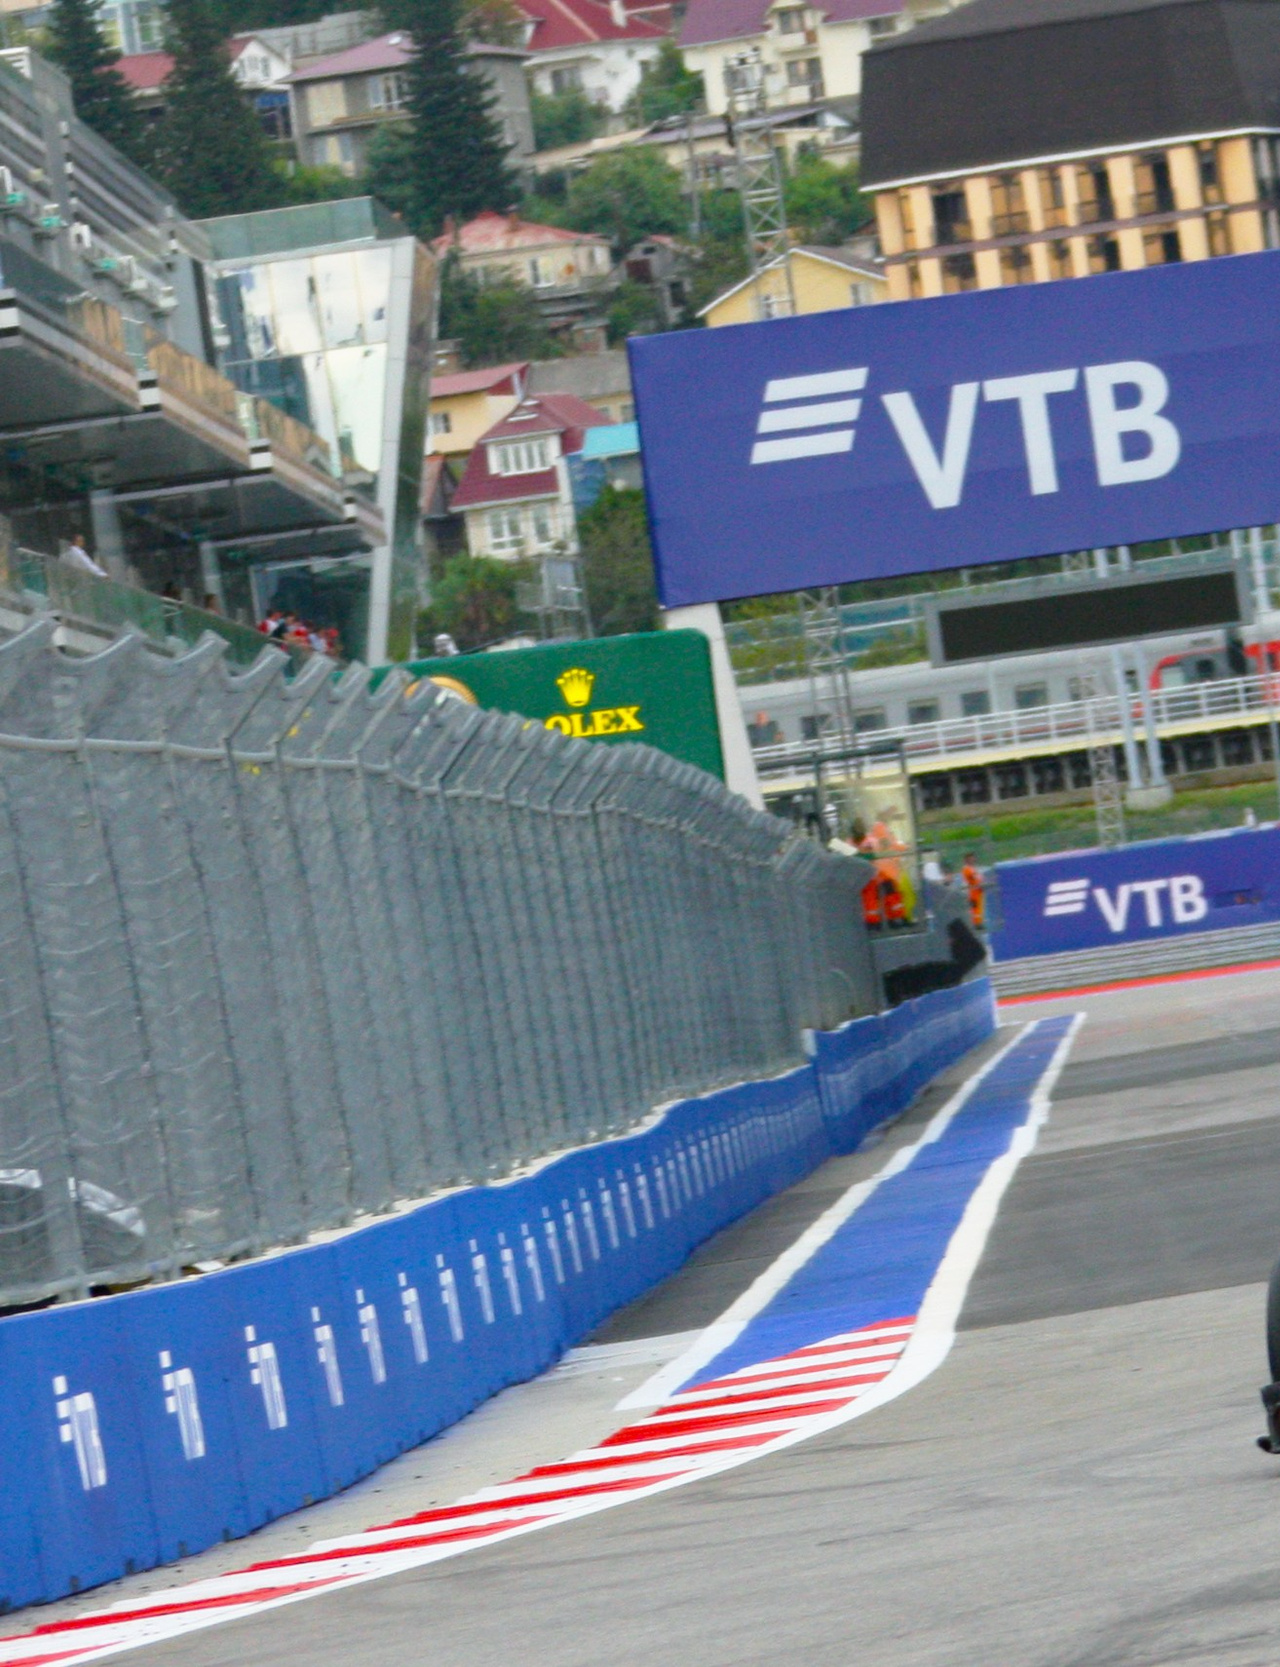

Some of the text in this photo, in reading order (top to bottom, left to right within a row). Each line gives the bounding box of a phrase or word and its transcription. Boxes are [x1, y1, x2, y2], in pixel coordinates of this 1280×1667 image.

[880, 360, 1181, 509] VTB
[522, 705, 644, 738] OLEX
[1090, 874, 1208, 932] VTB
